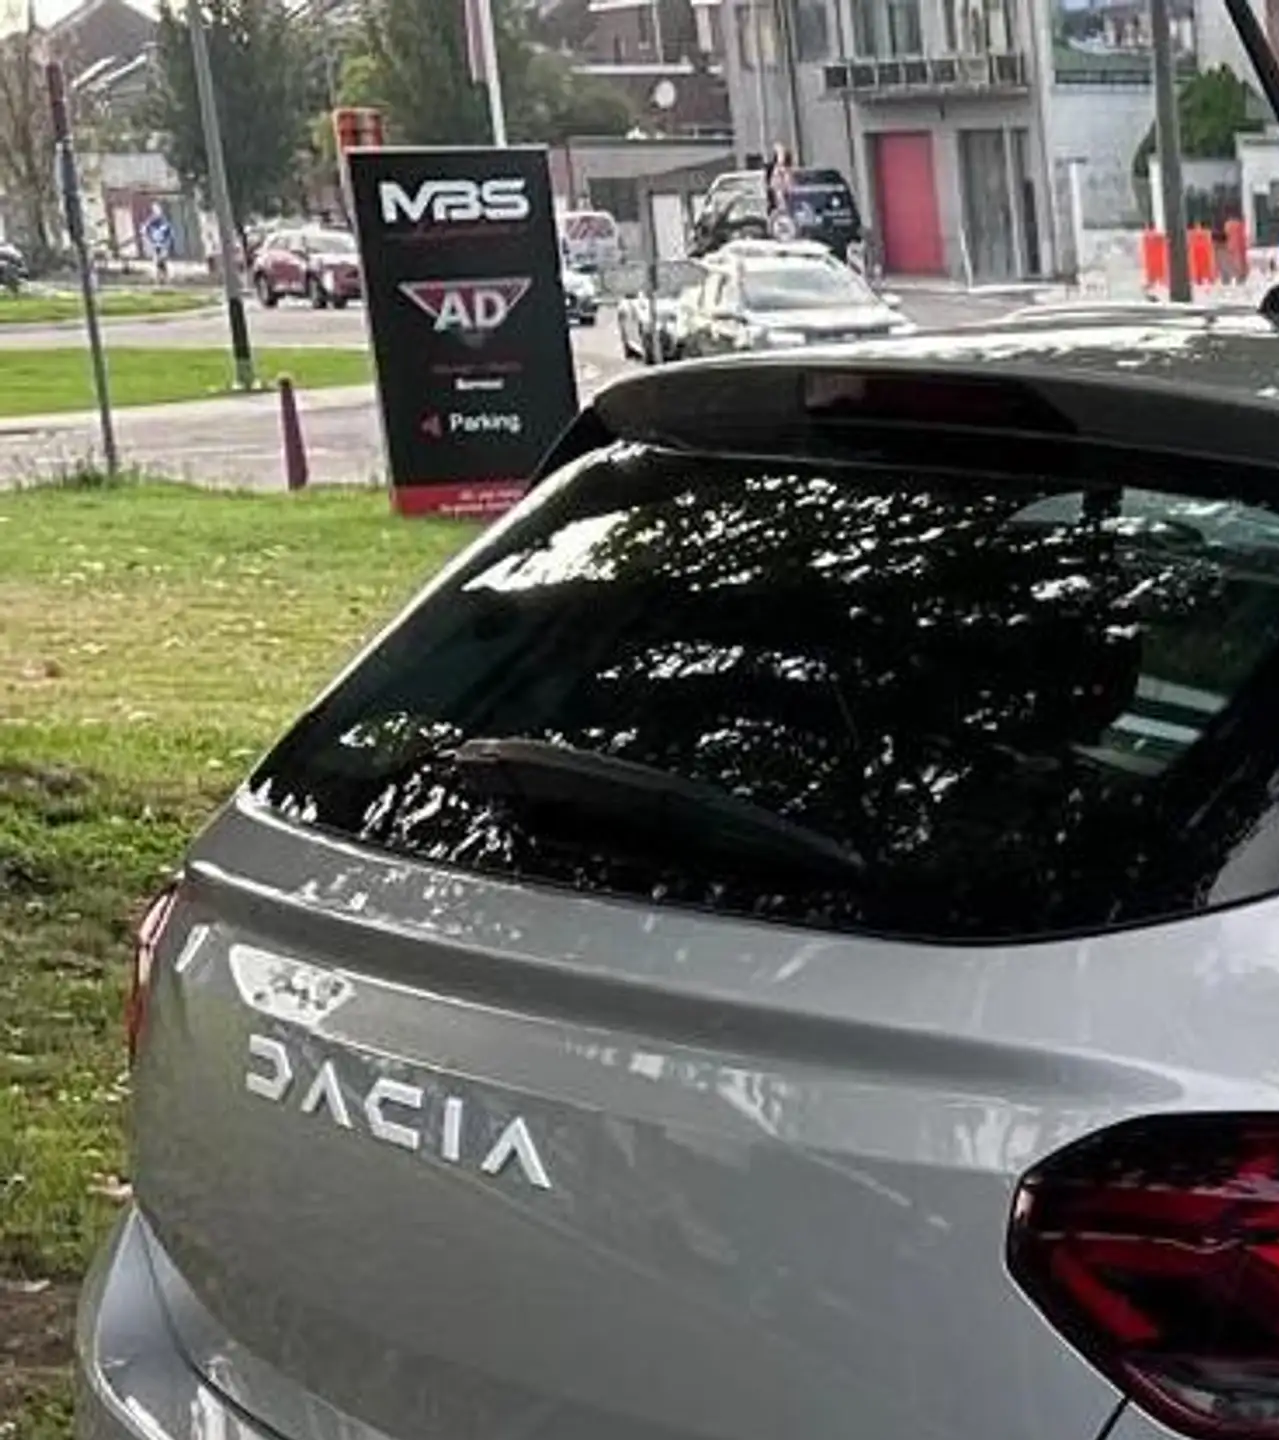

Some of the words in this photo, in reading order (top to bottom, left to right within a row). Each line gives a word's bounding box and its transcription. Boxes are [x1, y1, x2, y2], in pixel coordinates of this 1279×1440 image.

[379, 178, 530, 223] MBS
[434, 289, 507, 331] AD
[450, 412, 521, 433] Parking
[245, 1033, 551, 1189] DACIA
